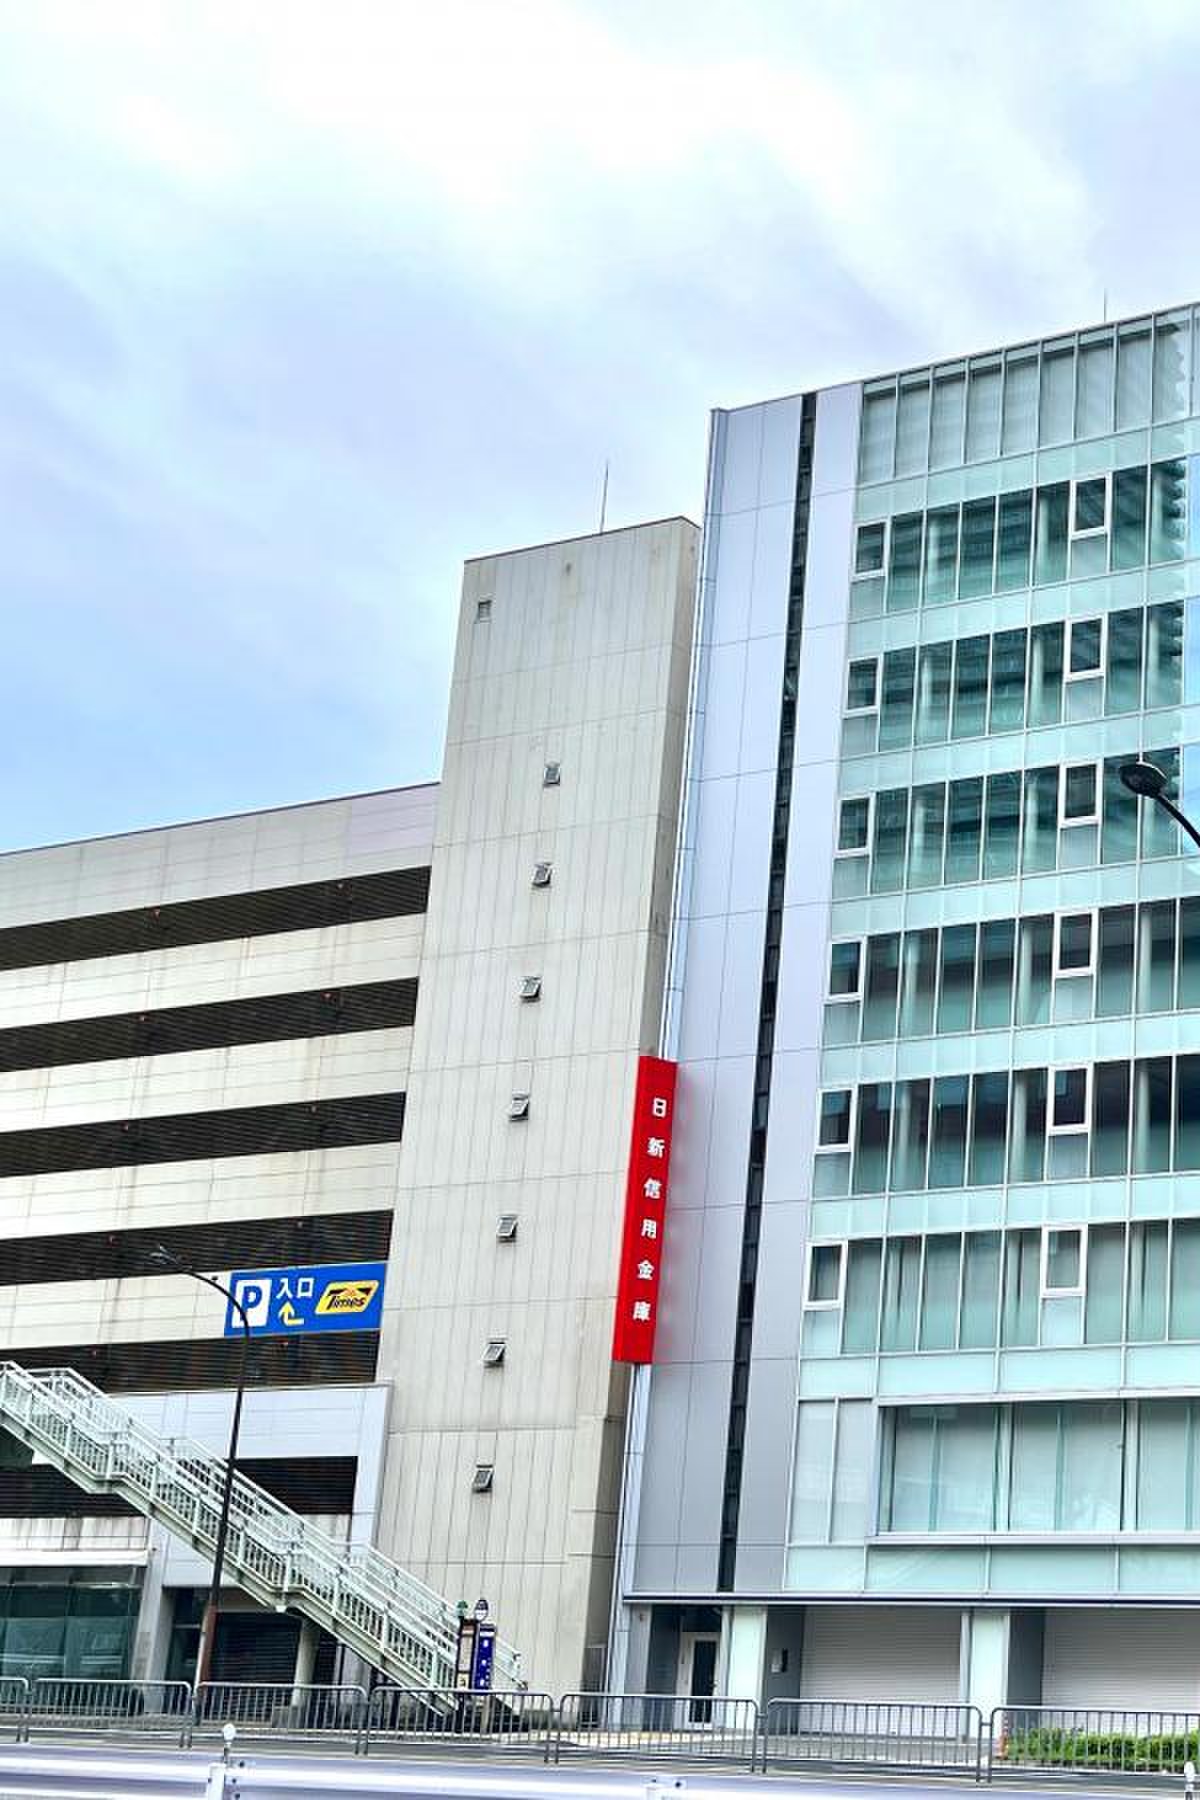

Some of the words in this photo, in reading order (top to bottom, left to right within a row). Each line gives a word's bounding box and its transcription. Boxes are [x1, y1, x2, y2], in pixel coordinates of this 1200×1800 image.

[632, 1096, 668, 1322] 日新信用金庫
[240, 1285, 263, 1318] P
[276, 1277, 315, 1299] 入口
[325, 1287, 373, 1311] Times
